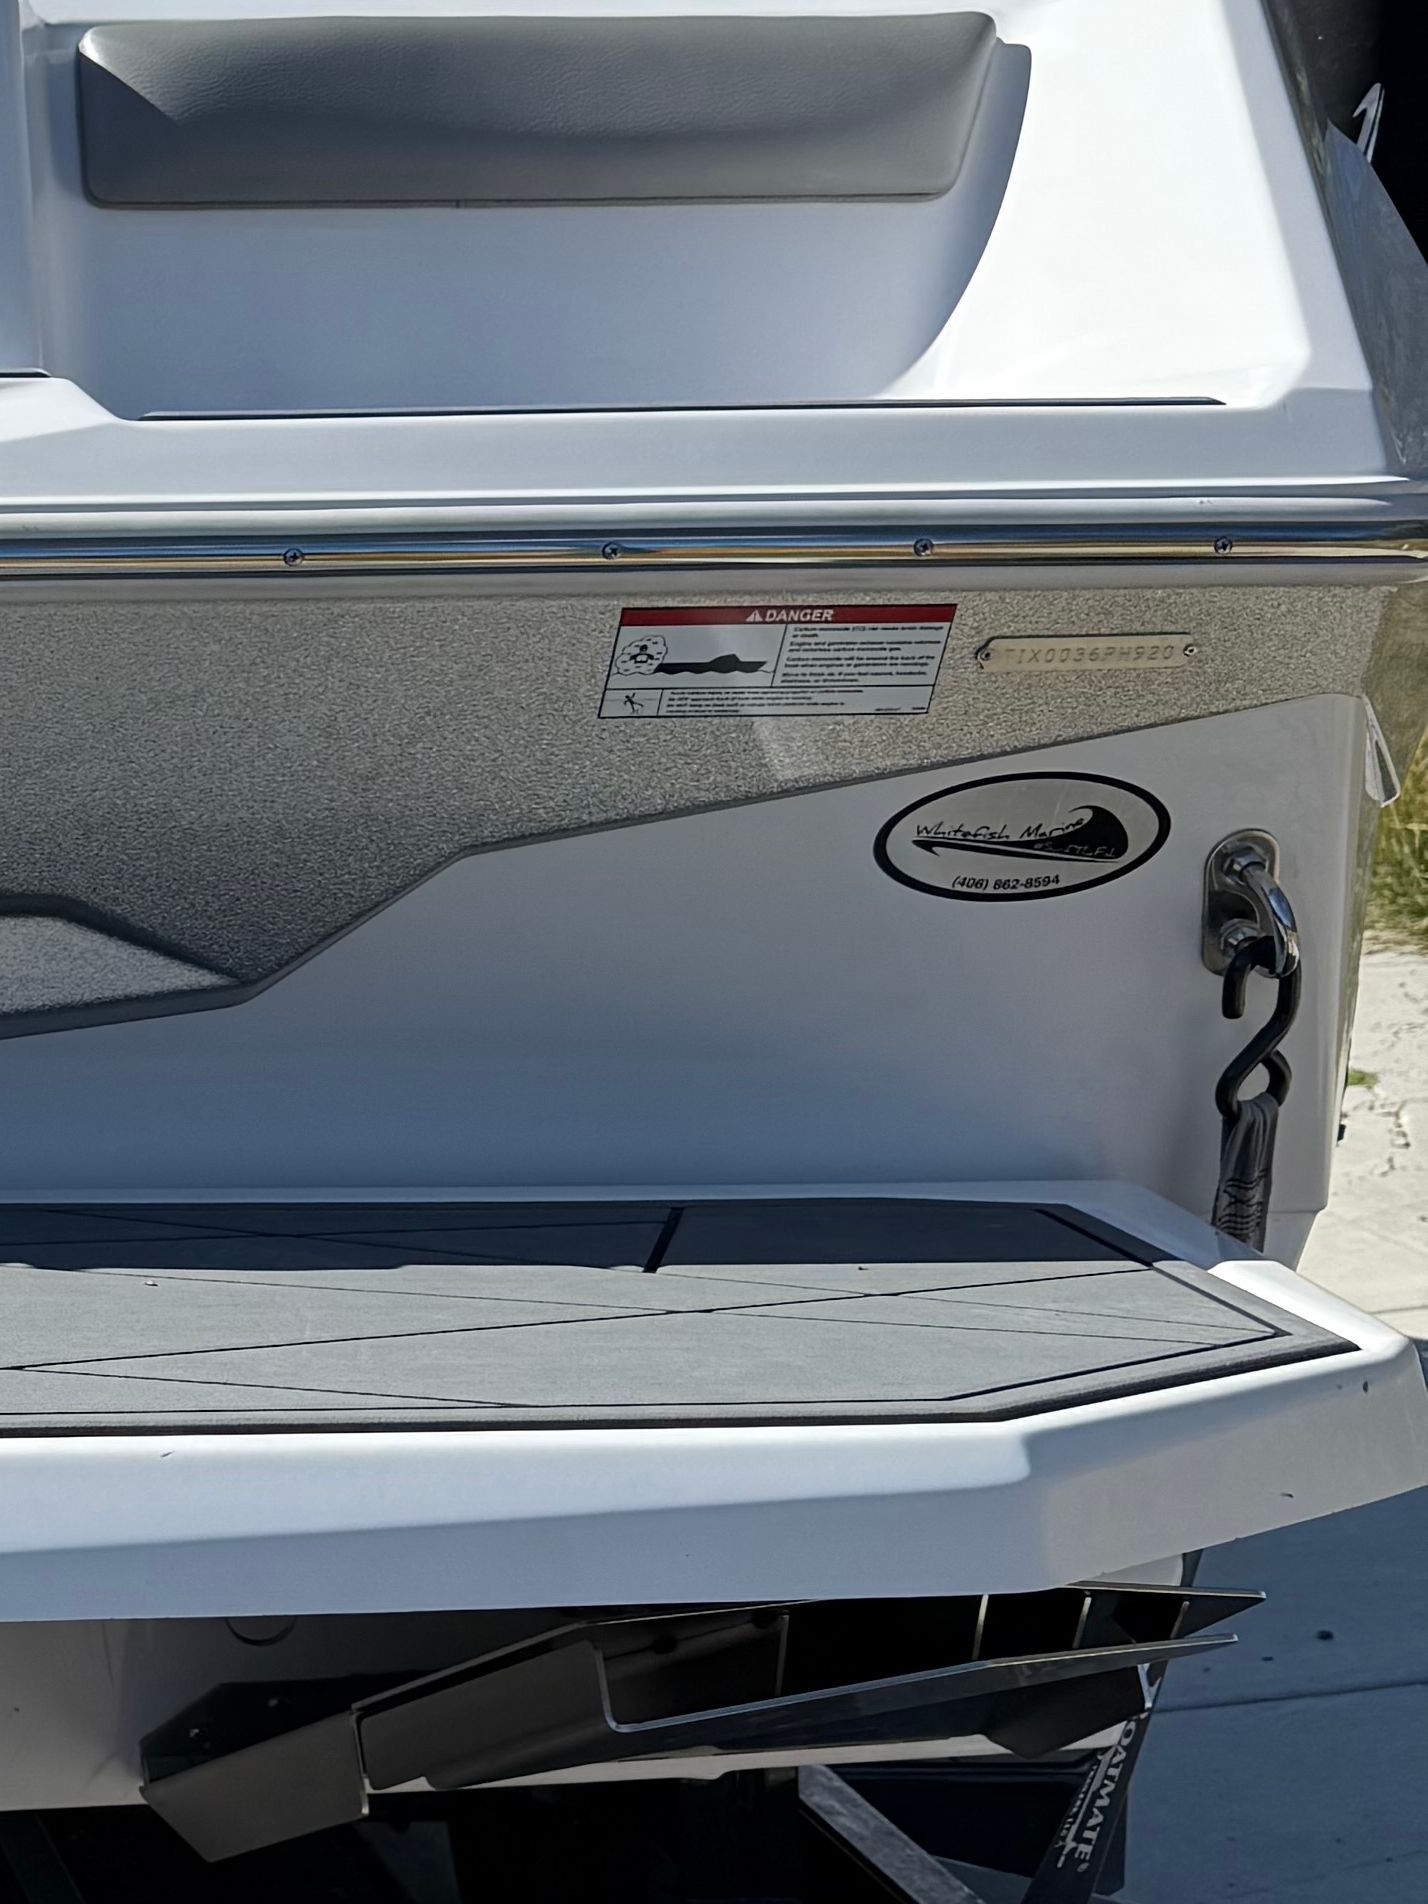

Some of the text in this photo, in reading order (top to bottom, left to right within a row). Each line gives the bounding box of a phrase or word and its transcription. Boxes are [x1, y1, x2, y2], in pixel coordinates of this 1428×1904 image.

[765, 609, 835, 622] DANGER
[916, 817, 1085, 840] Whitefish Marine
[1074, 1720, 1137, 1862] OATMATE
